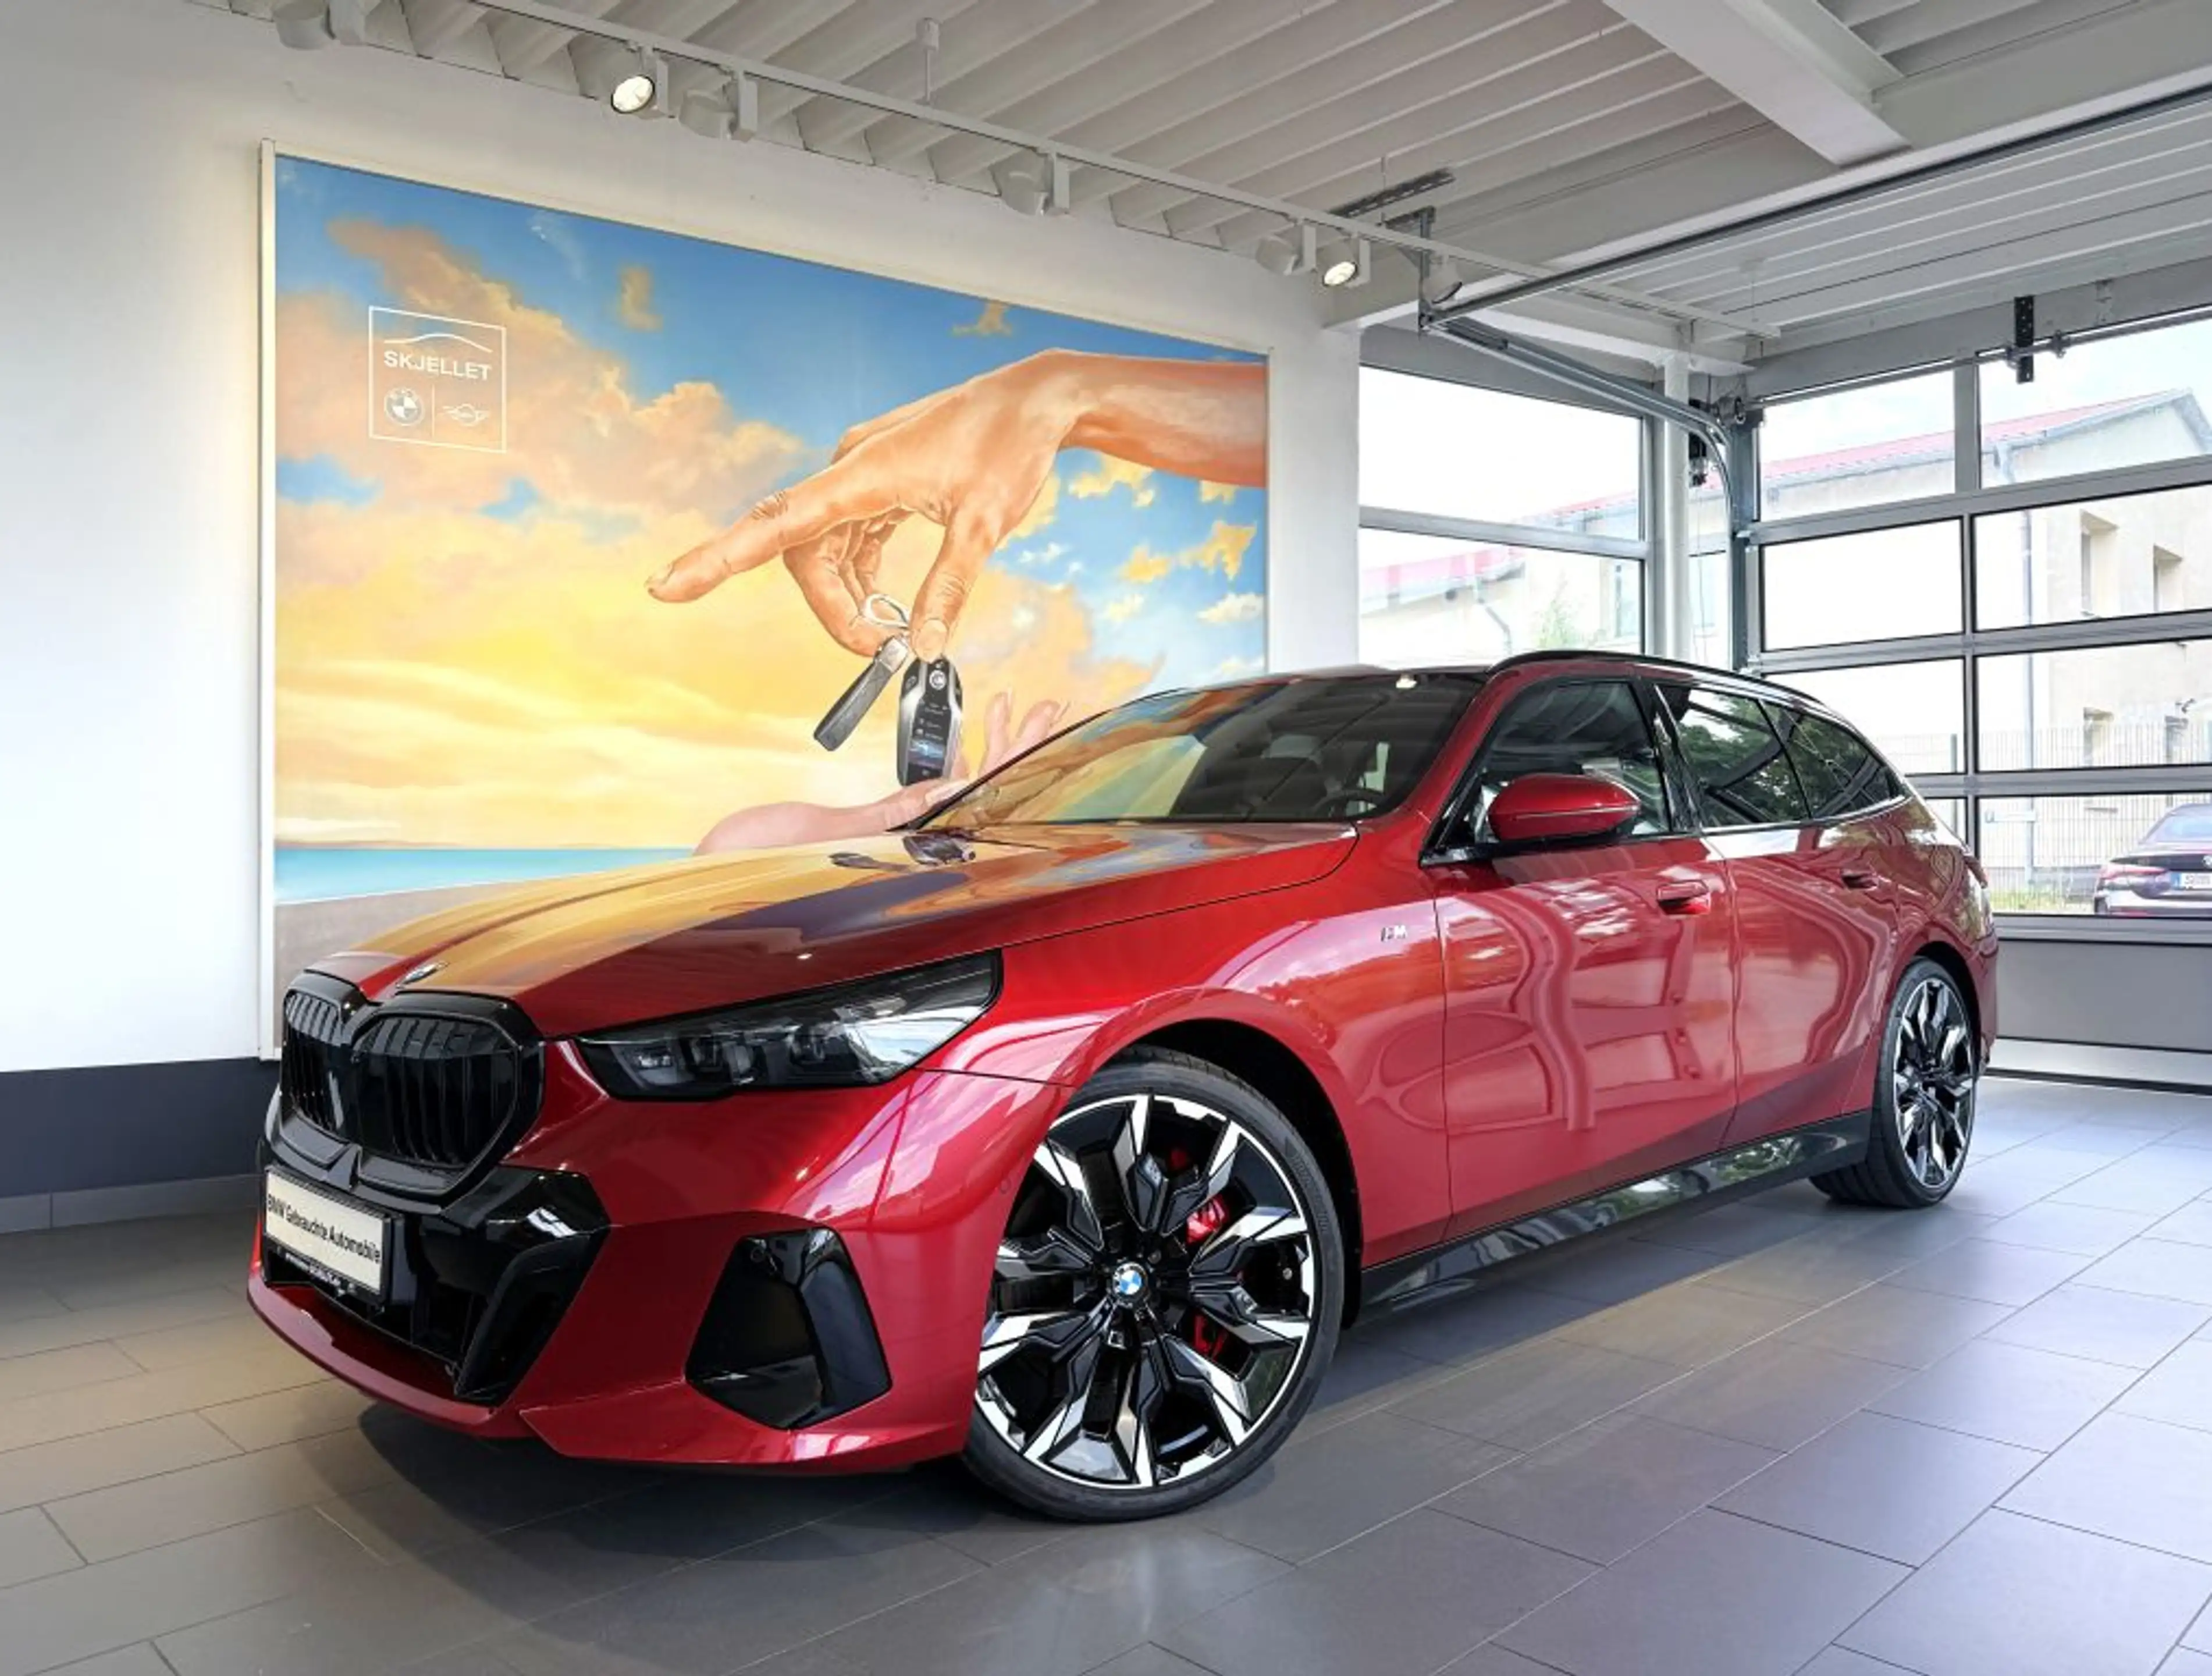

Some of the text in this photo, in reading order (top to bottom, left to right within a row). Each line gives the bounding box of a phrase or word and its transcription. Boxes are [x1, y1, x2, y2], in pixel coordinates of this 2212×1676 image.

[384, 350, 492, 381] SKJELLET
[268, 1193, 285, 1219] BMW
[329, 1224, 380, 1264] Automobile
